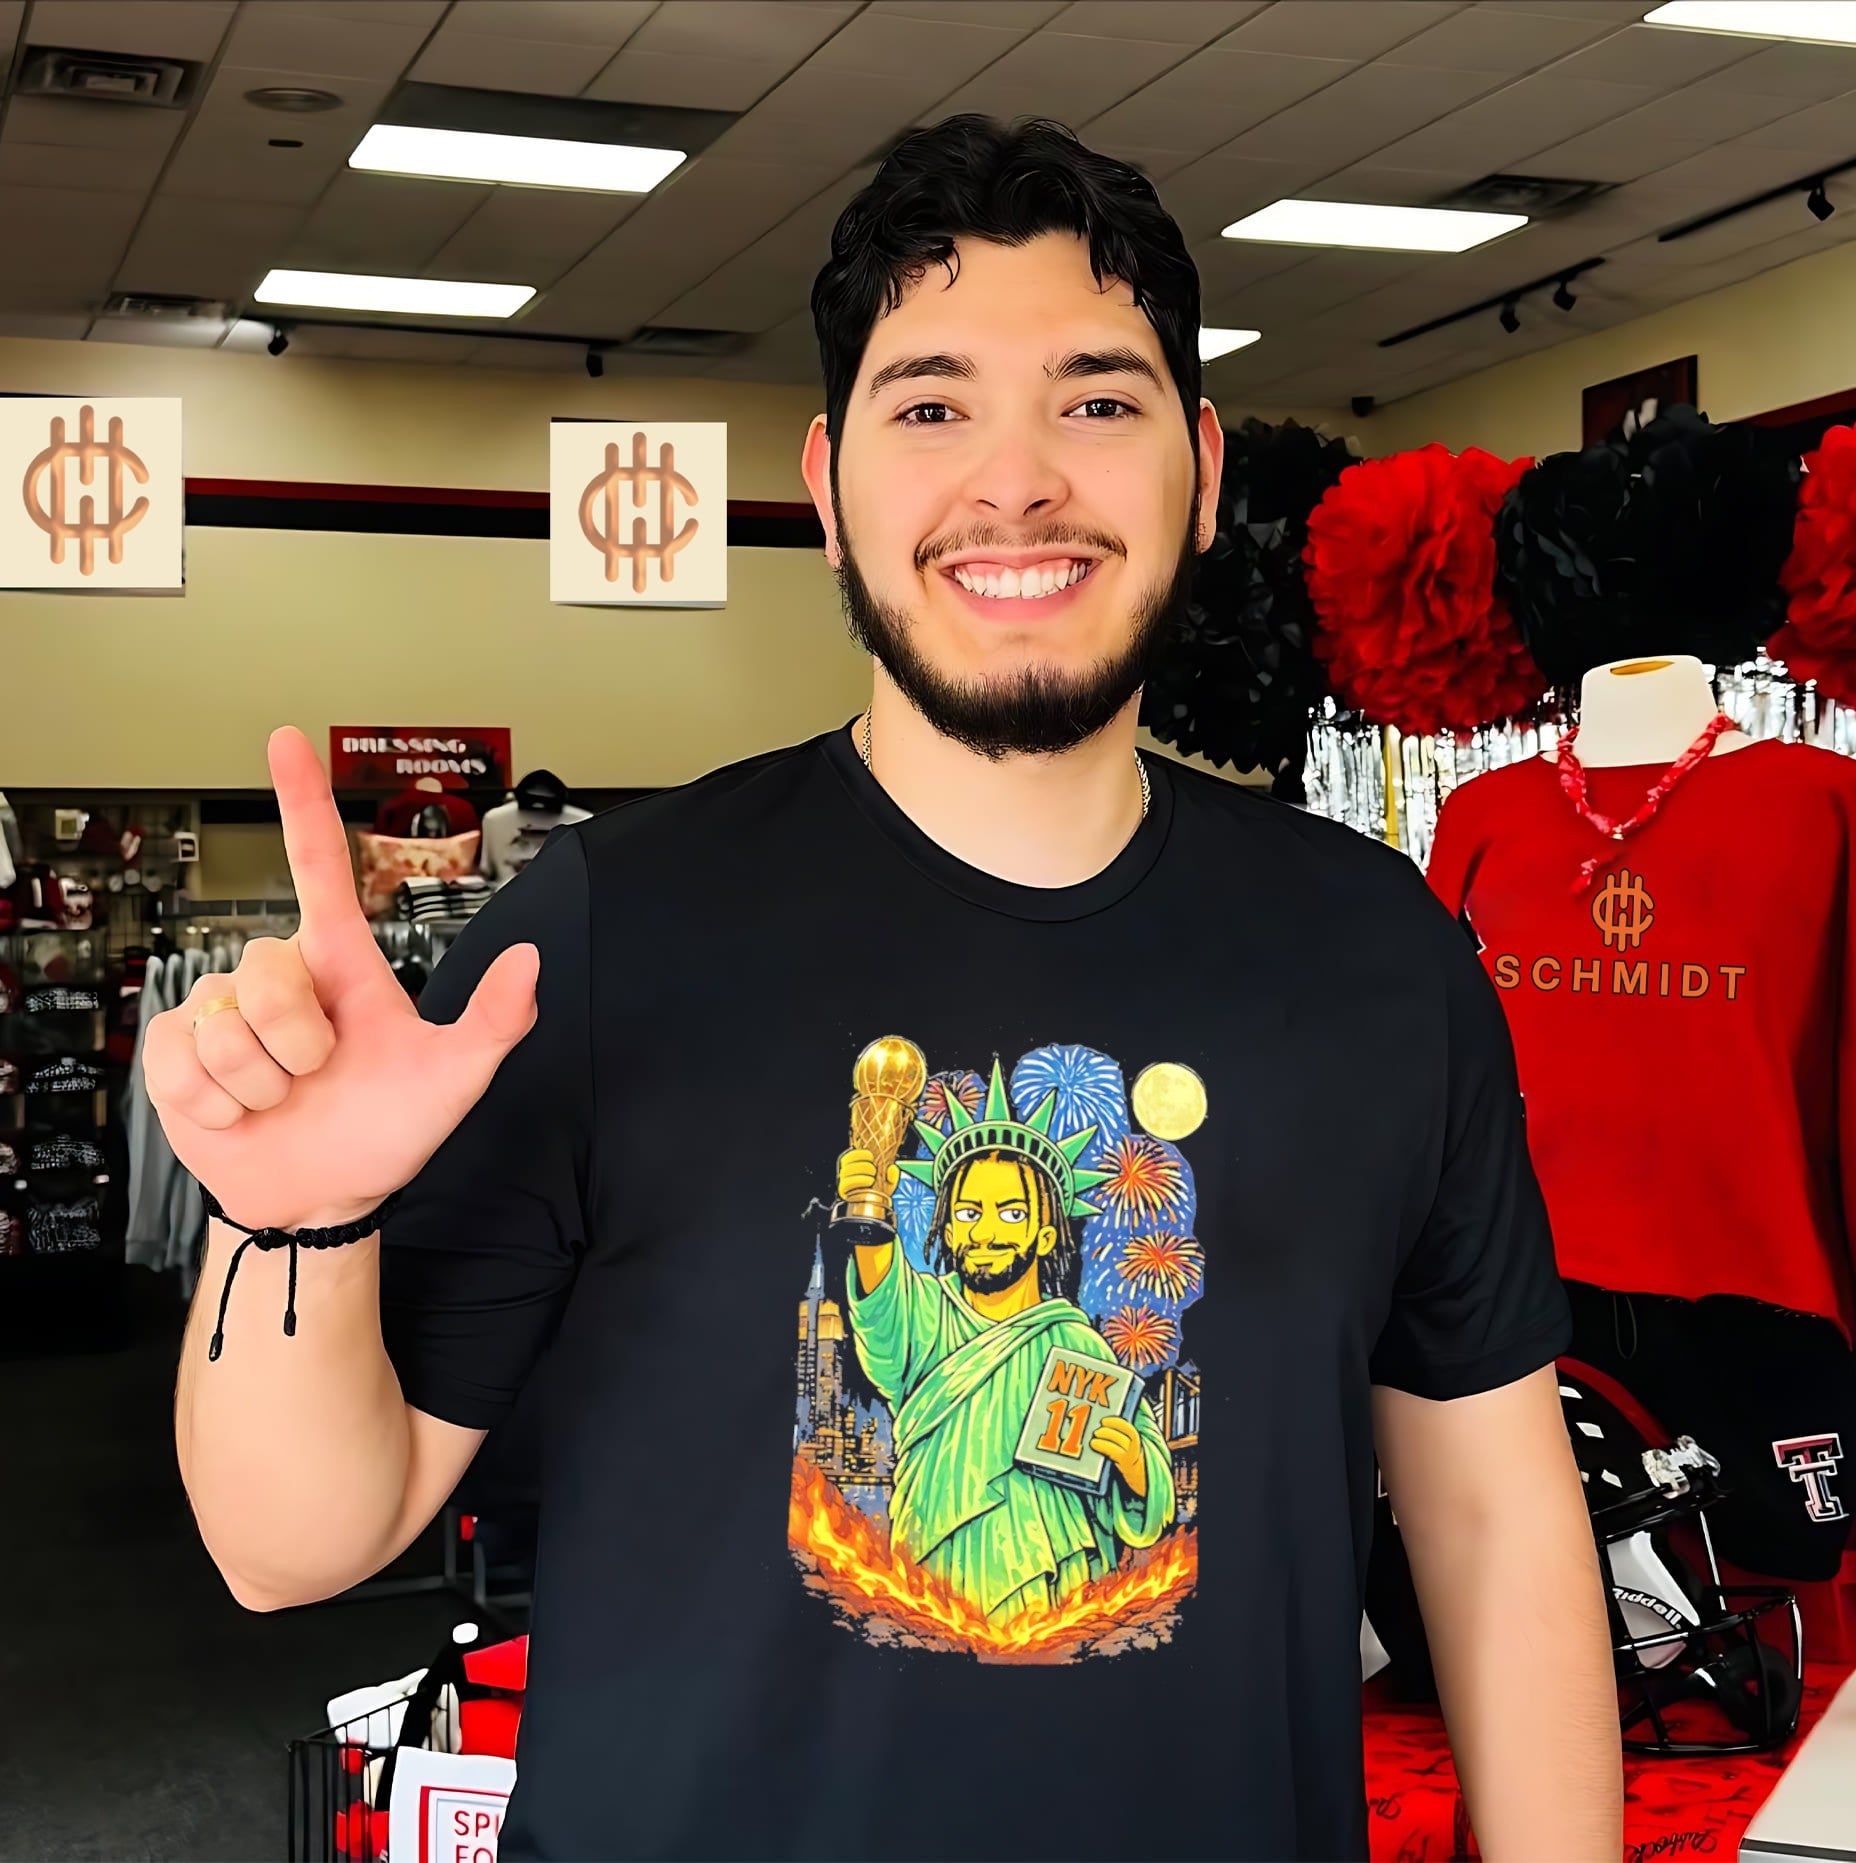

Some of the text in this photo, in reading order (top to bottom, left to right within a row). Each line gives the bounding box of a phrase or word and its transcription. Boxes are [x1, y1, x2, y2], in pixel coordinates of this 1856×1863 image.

[396, 758, 487, 774] ROOMS
[1494, 954, 1746, 1000] SCHMIDT
[1047, 1360, 1119, 1408] NYK
[1036, 1398, 1092, 1460] 11
